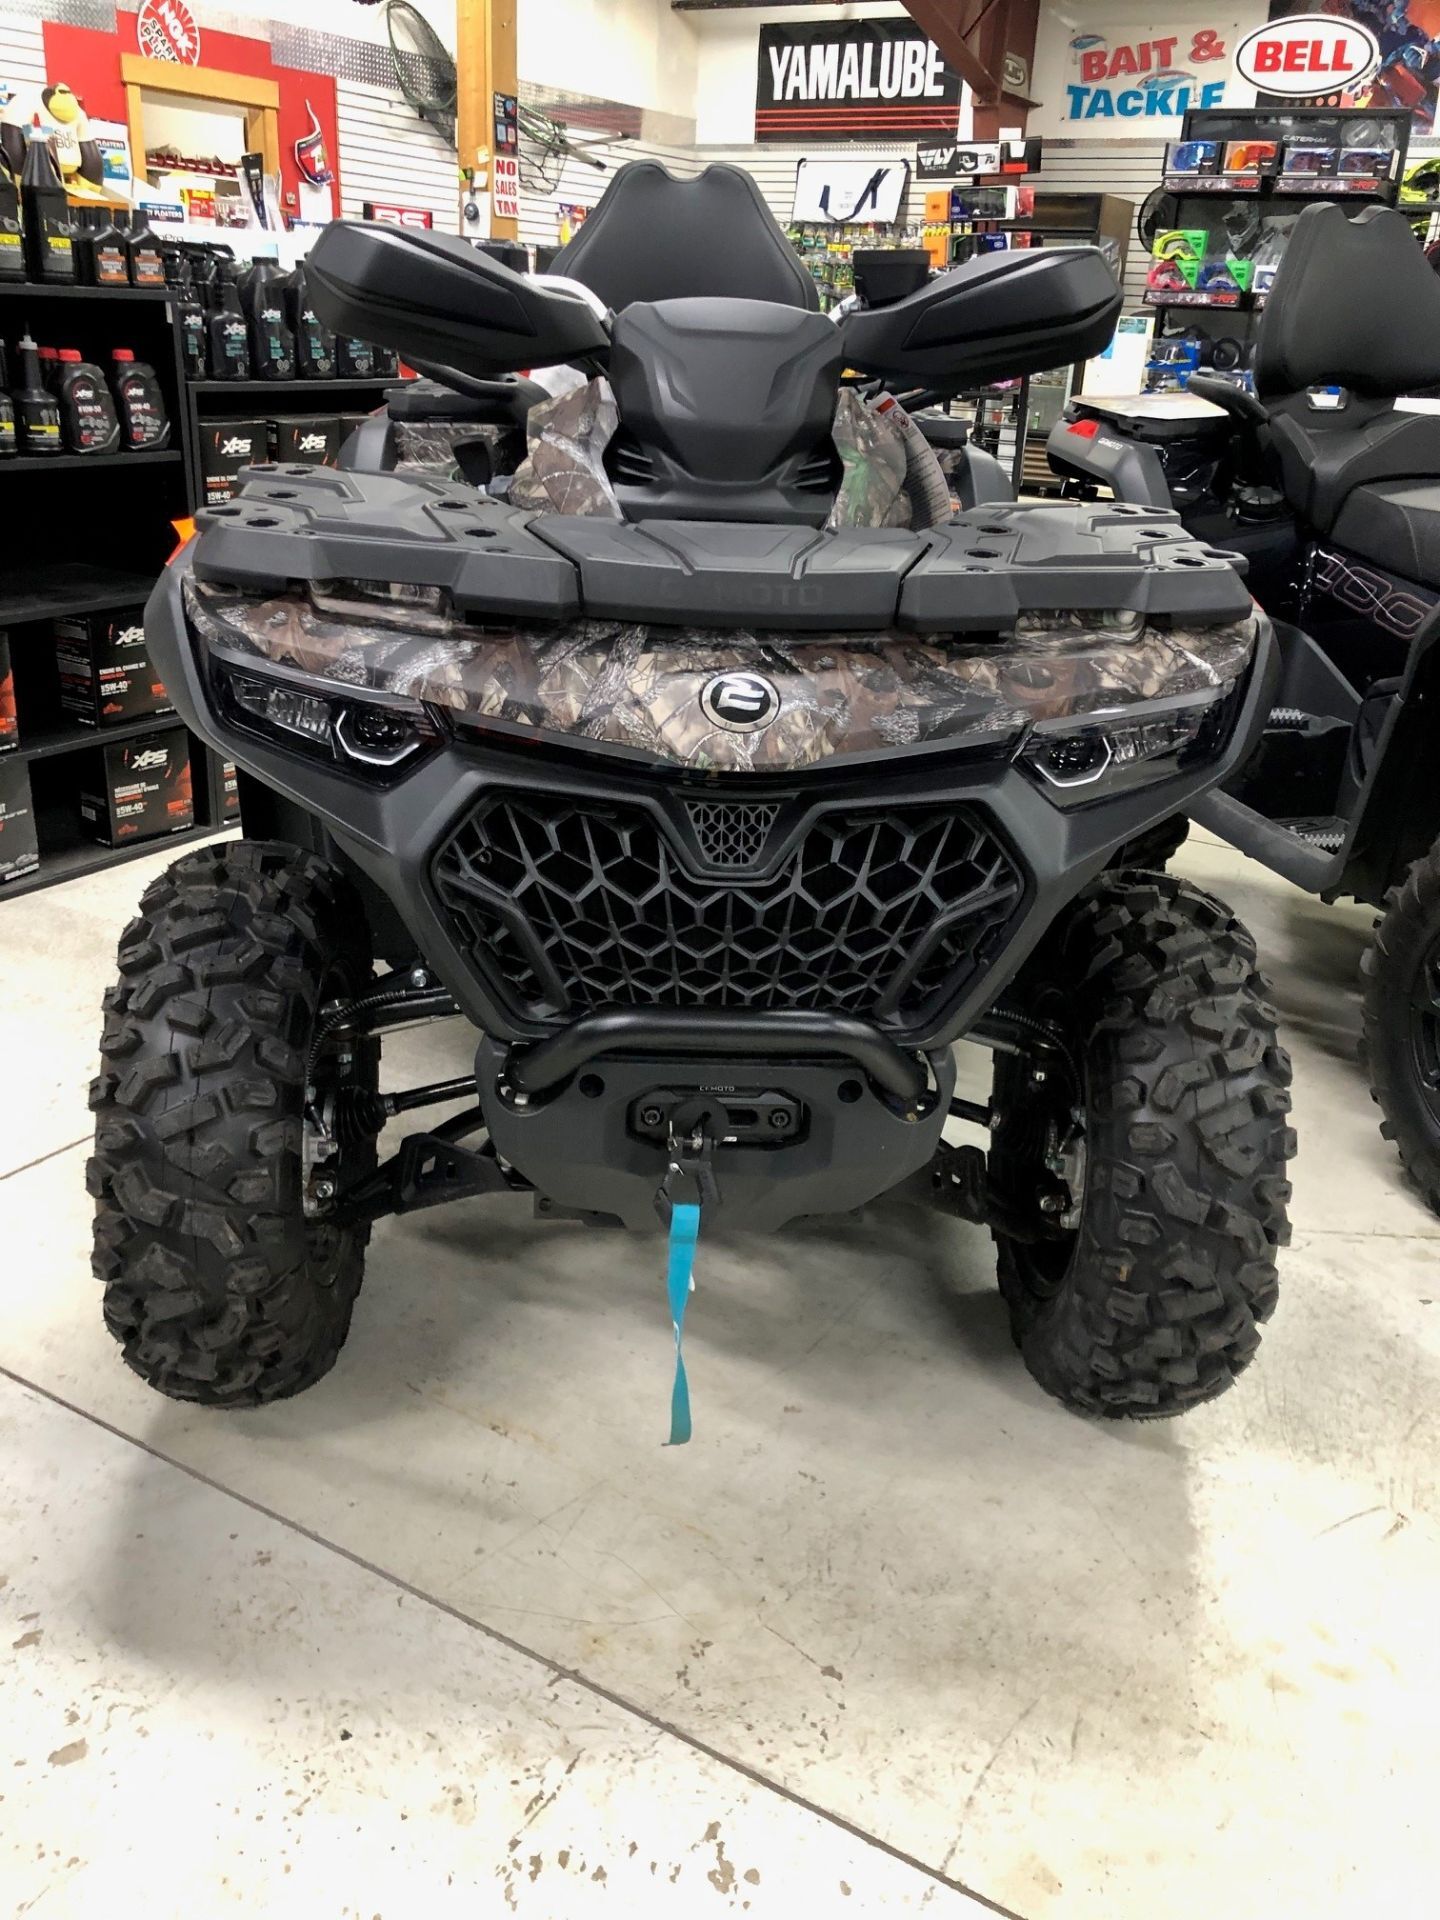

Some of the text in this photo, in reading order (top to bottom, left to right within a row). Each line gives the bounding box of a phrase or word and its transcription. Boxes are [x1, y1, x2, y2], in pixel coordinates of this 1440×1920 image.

[1081, 29, 1226, 83] BAIT &
[1254, 39, 1353, 73] BELL
[769, 40, 945, 100] YAMALUBE
[917, 147, 956, 167] FLY
[496, 159, 516, 176] NO
[495, 180, 517, 196] SALES
[496, 199, 519, 216] TAX
[222, 321, 247, 336] XPS
[220, 436, 253, 454] XPS
[299, 433, 328, 450] XPS
[131, 749, 168, 768] XPS
